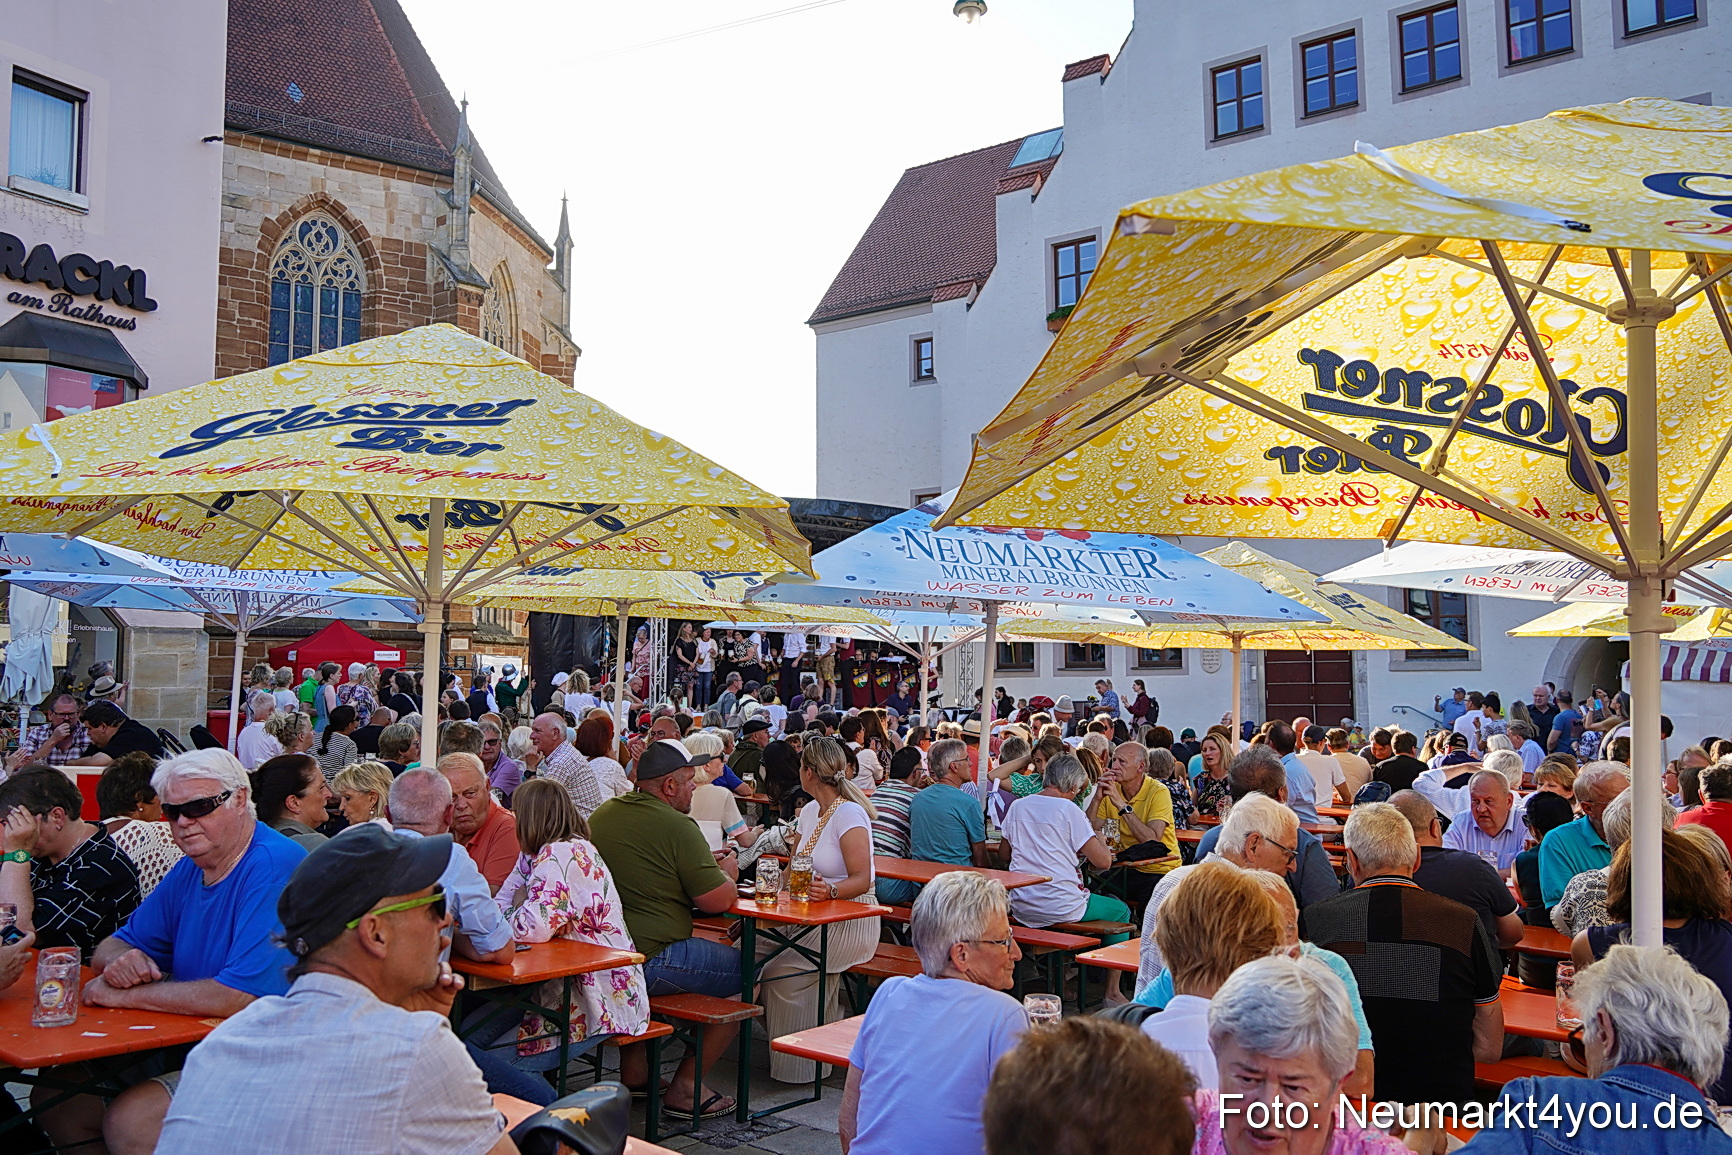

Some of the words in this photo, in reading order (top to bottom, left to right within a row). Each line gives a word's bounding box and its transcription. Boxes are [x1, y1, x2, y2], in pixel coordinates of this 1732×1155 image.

[7, 291, 44, 310] am
[48, 293, 137, 331] Rathaus
[158, 399, 538, 459] Glossner
[334, 427, 506, 458] Bier
[342, 456, 548, 482] Biergenuss
[900, 527, 1173, 579] NEUMARKTER
[169, 566, 308, 586] NERALBRUNNEN
[941, 564, 1151, 594] MINERALBRUNNEN
[928, 580, 1029, 597] WASSER
[1042, 588, 1094, 601] ZUM
[1107, 593, 1174, 607] LEBEN
